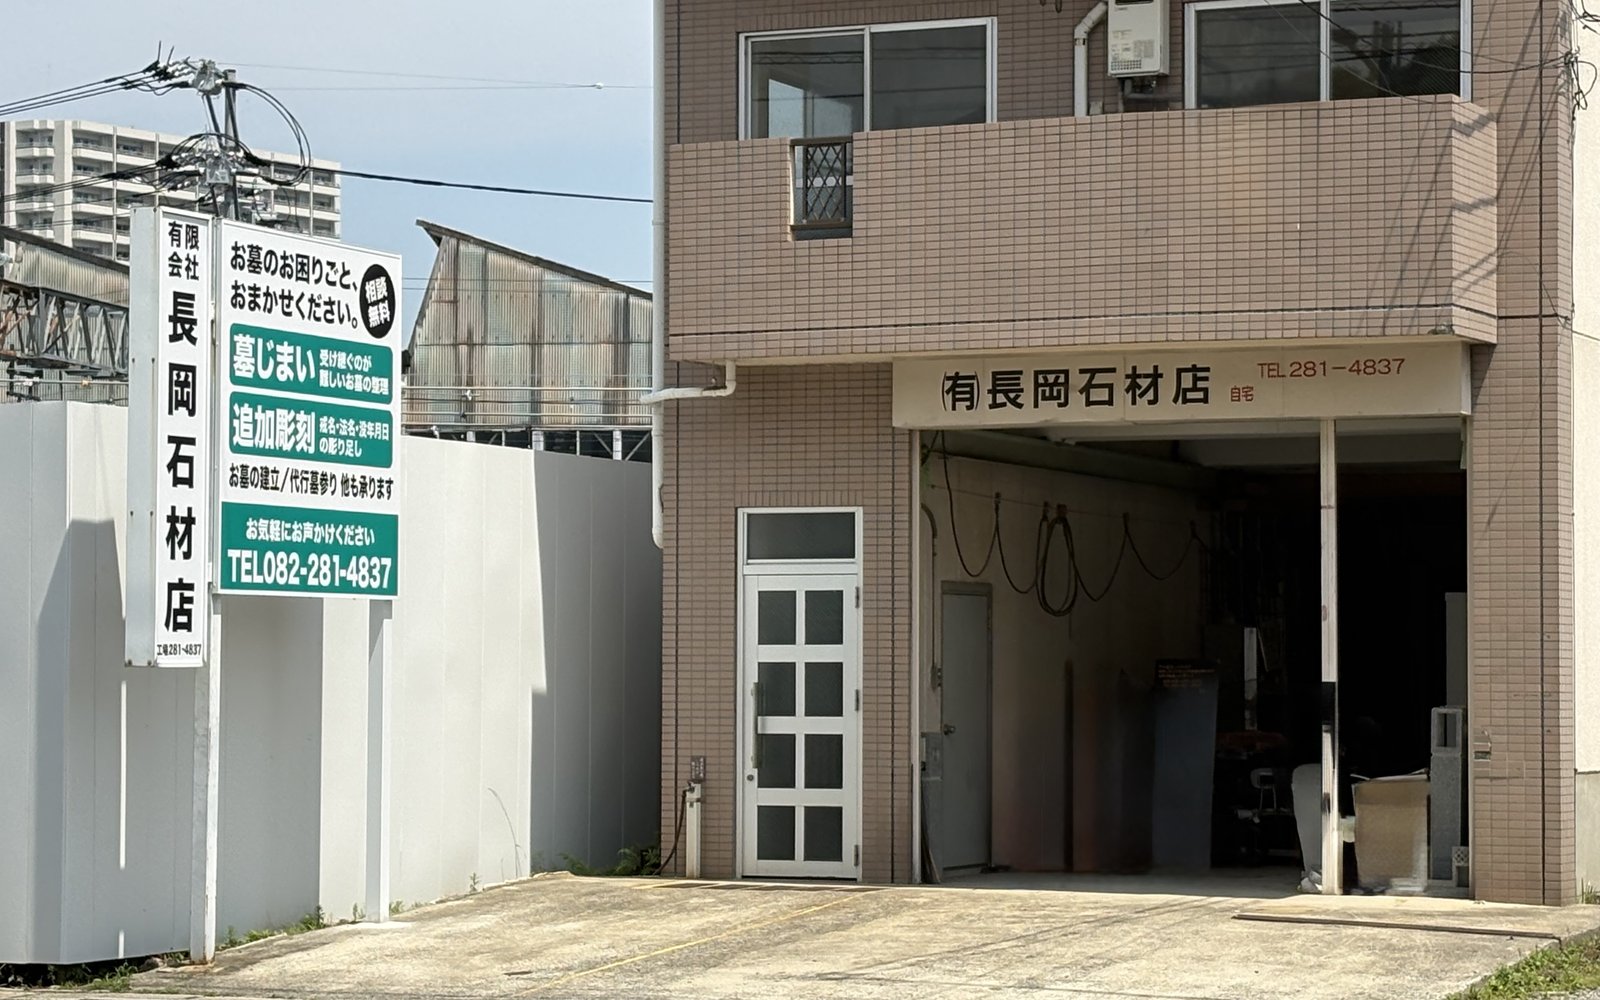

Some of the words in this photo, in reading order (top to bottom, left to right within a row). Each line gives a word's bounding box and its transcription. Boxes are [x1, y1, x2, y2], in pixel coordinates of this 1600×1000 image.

[168, 221, 199, 251] 有限
[168, 251, 199, 281] 会社
[230, 241, 358, 291] お墓のお困りごと、
[230, 280, 358, 329] おまかせください。
[365, 276, 388, 304] 相談
[368, 299, 390, 328] 無料
[233, 333, 316, 383] 墓じまい
[319, 349, 372, 373] 受け継ぐのが
[319, 369, 389, 395] 難しいお墓の整理
[1230, 385, 1254, 402] 自宅
[232, 404, 316, 454] 追加彫刻
[319, 415, 390, 441] 戒名・法名・没年月日
[164, 291, 199, 633] 長岡石材店
[319, 437, 363, 458] の彫り足し
[340, 472, 394, 501] 他も承ります
[245, 517, 375, 546] お気軽にお声かけください
[227, 549, 392, 589] TEL082-281-4837
